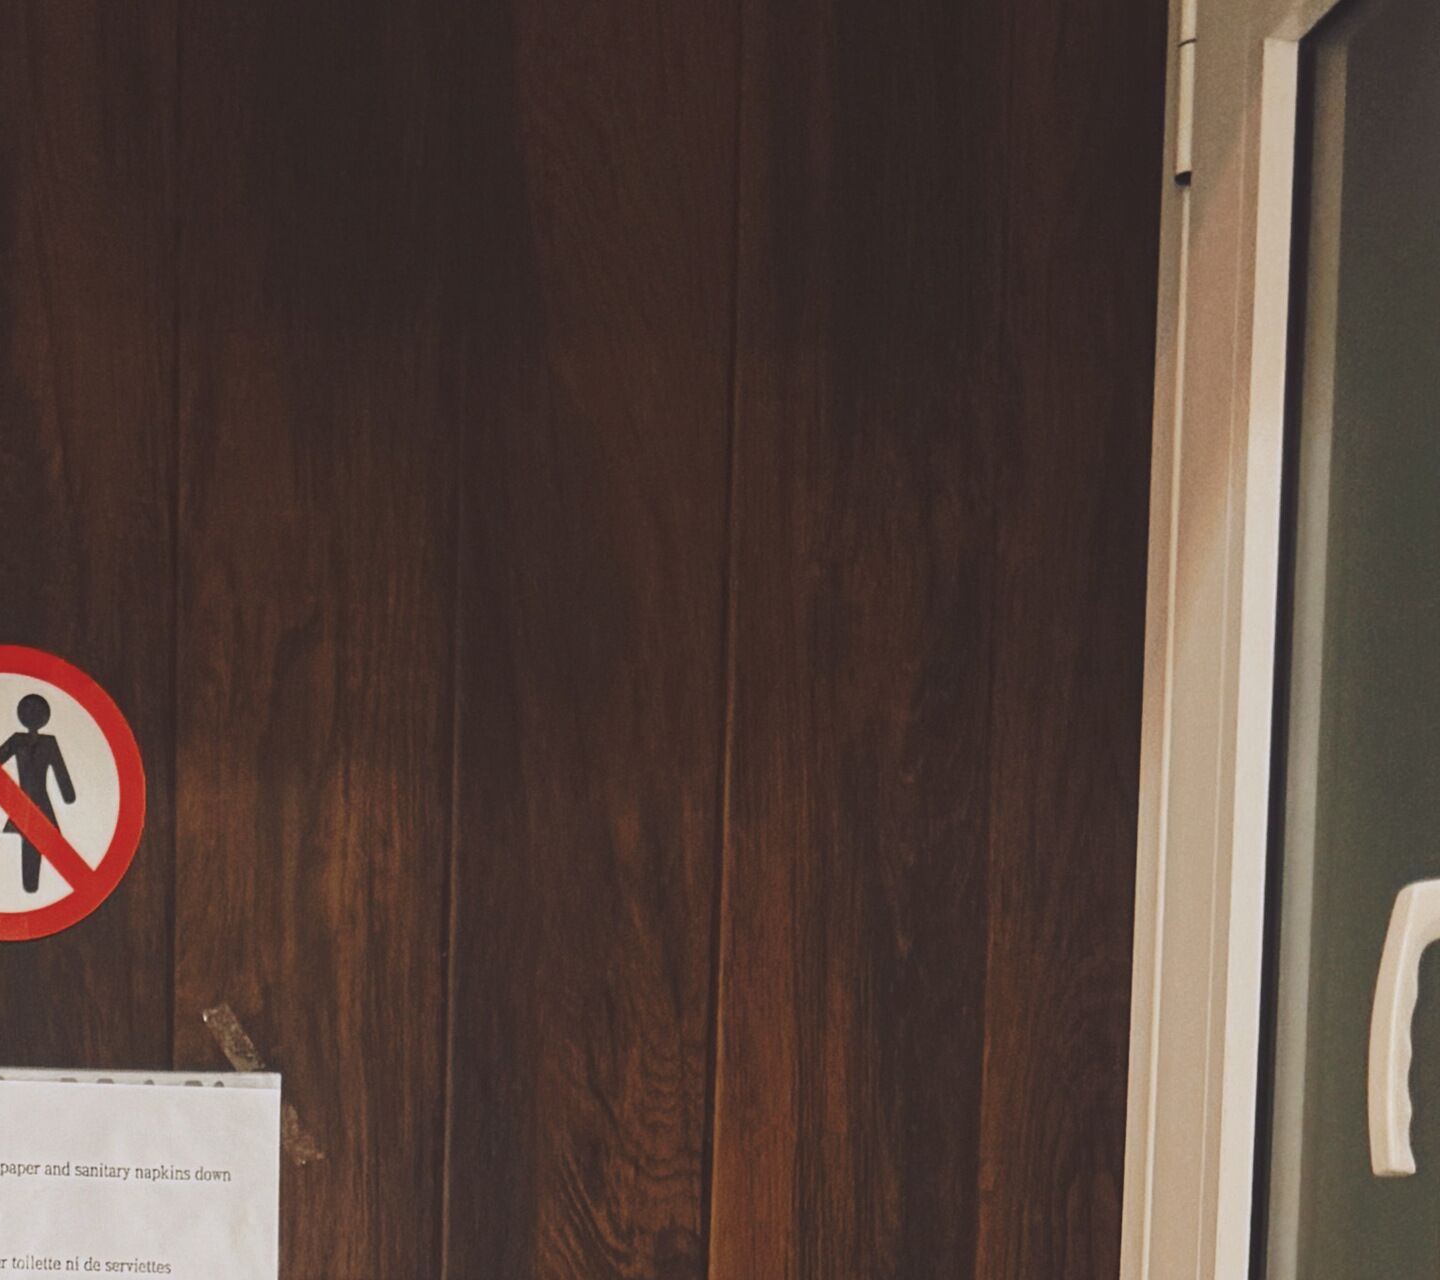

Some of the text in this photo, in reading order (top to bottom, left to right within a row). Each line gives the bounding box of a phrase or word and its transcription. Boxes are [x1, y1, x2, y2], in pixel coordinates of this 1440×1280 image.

[0, 1162, 41, 1177] paper
[45, 1160, 70, 1177] and
[75, 1162, 131, 1181] sanitary
[135, 1164, 191, 1182] napkins
[195, 1165, 232, 1183] down
[12, 1255, 62, 1271] toilette
[66, 1256, 79, 1272] ni
[84, 1257, 101, 1273] de
[105, 1258, 172, 1275] serviettes
